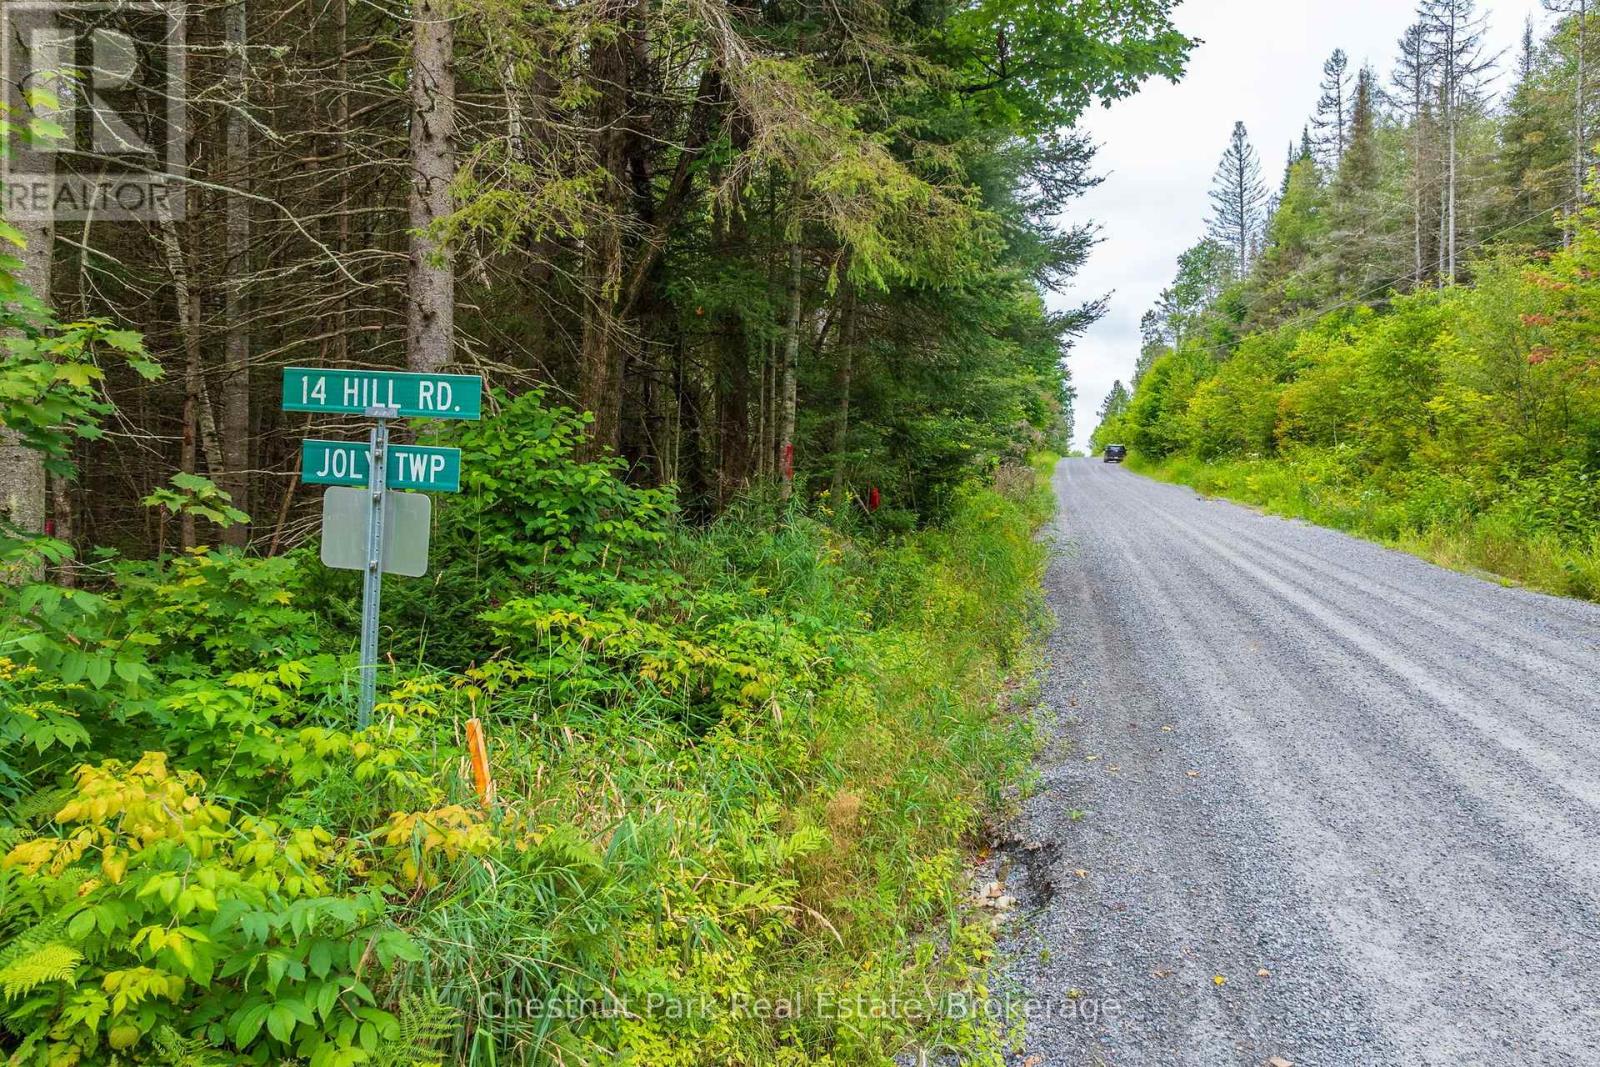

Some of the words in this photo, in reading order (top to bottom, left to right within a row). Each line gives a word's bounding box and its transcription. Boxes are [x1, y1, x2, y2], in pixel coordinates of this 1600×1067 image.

[301, 375, 327, 405] 14
[343, 377, 401, 409] HILL
[418, 380, 461, 412] RD.
[395, 452, 445, 483] TWP
